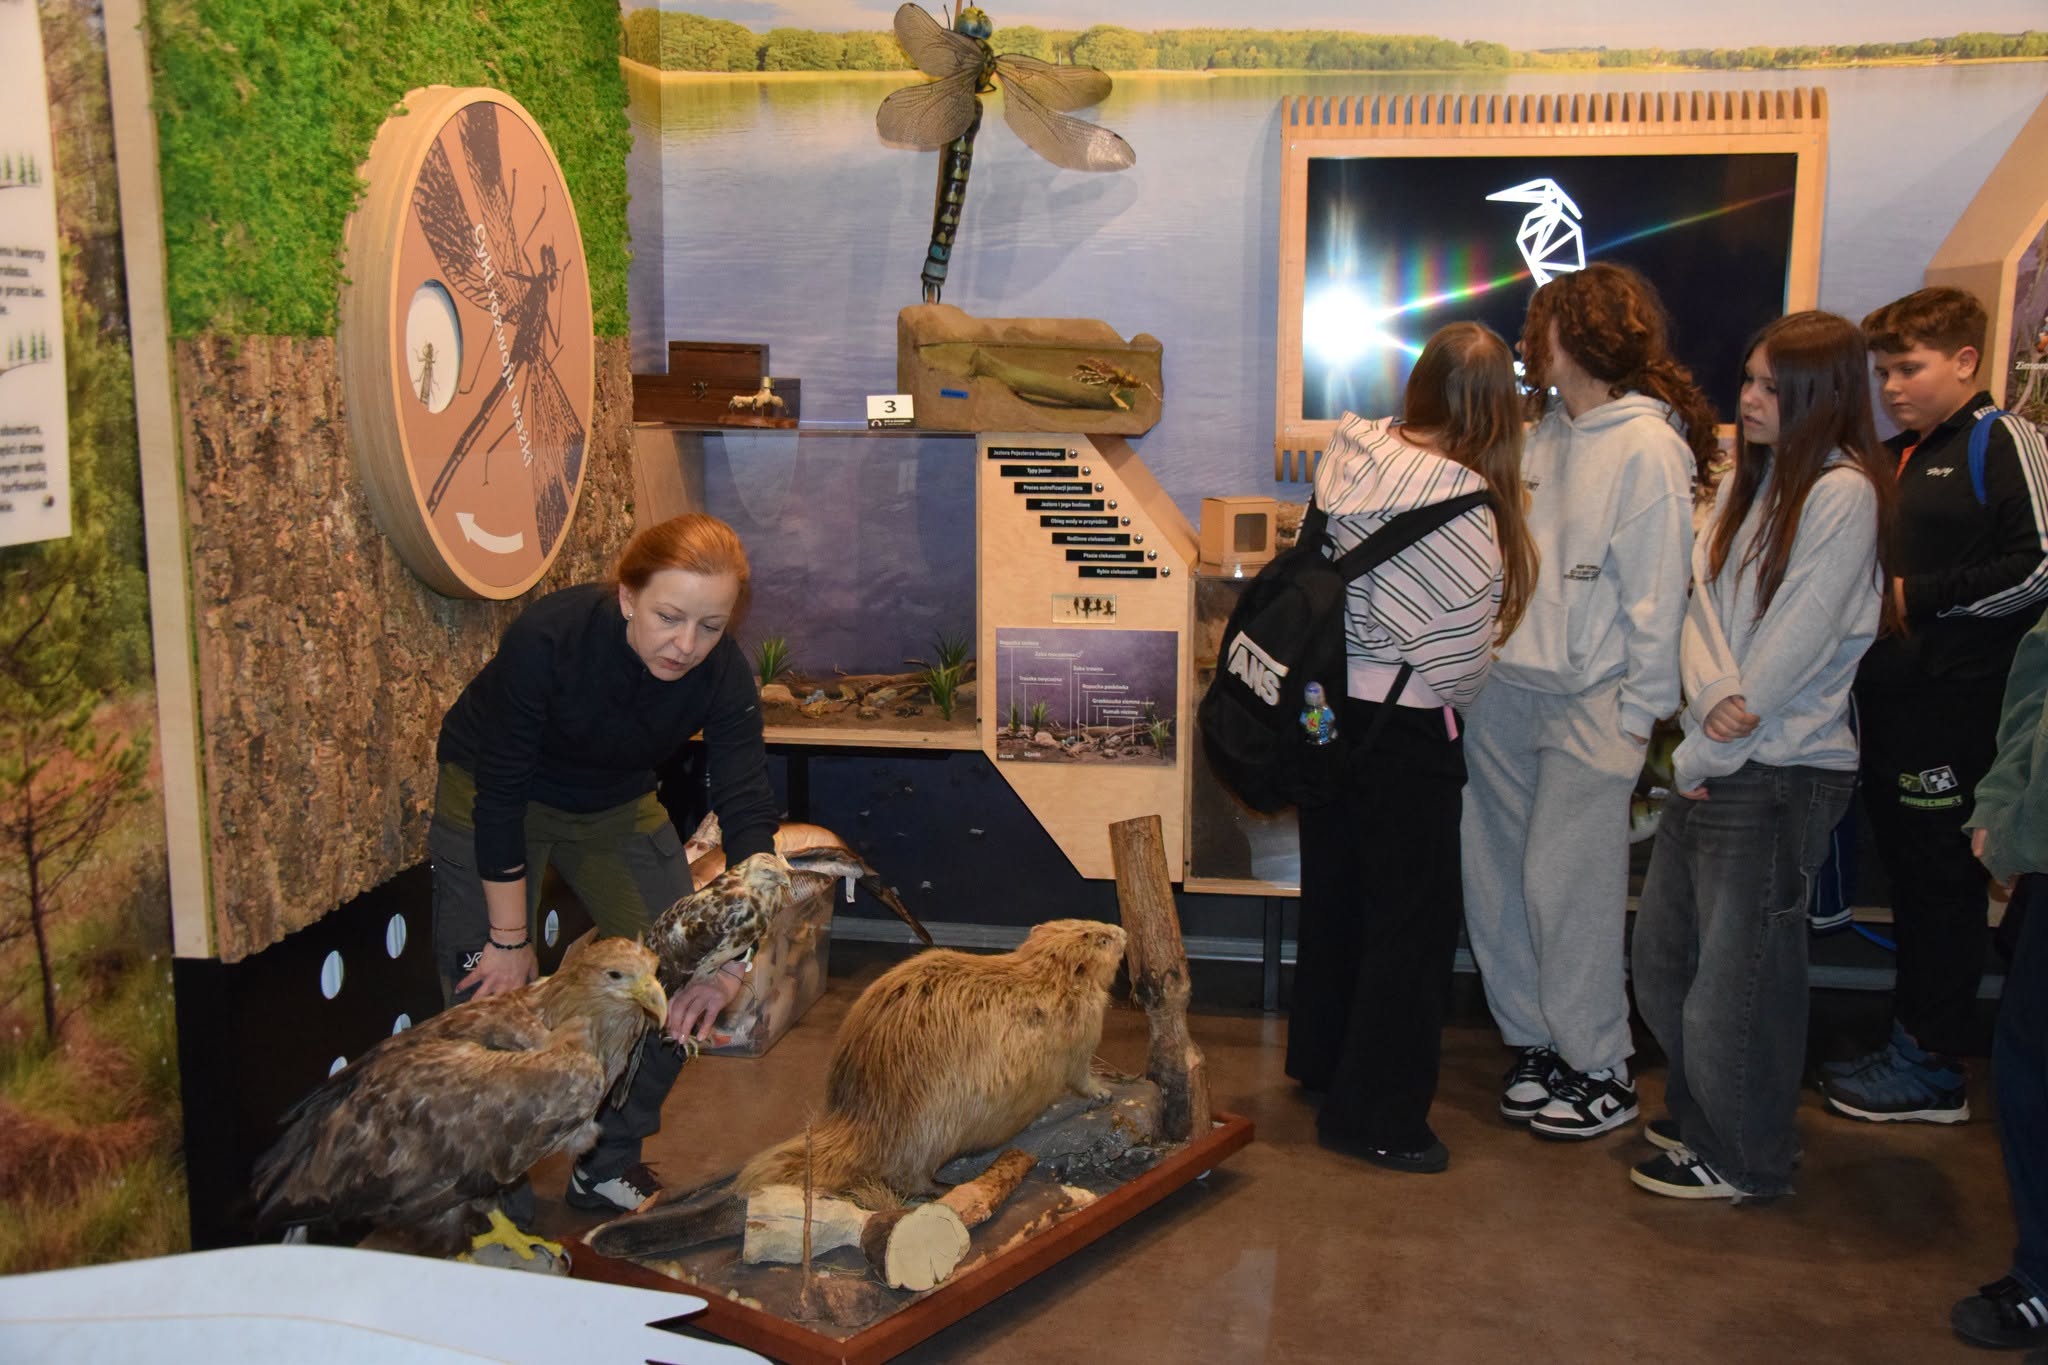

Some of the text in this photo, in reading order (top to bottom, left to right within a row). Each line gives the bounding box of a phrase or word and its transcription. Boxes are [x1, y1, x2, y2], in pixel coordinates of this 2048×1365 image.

[474, 222, 534, 468] Cykl rozwoju ważki
[884, 400, 897, 414] 3
